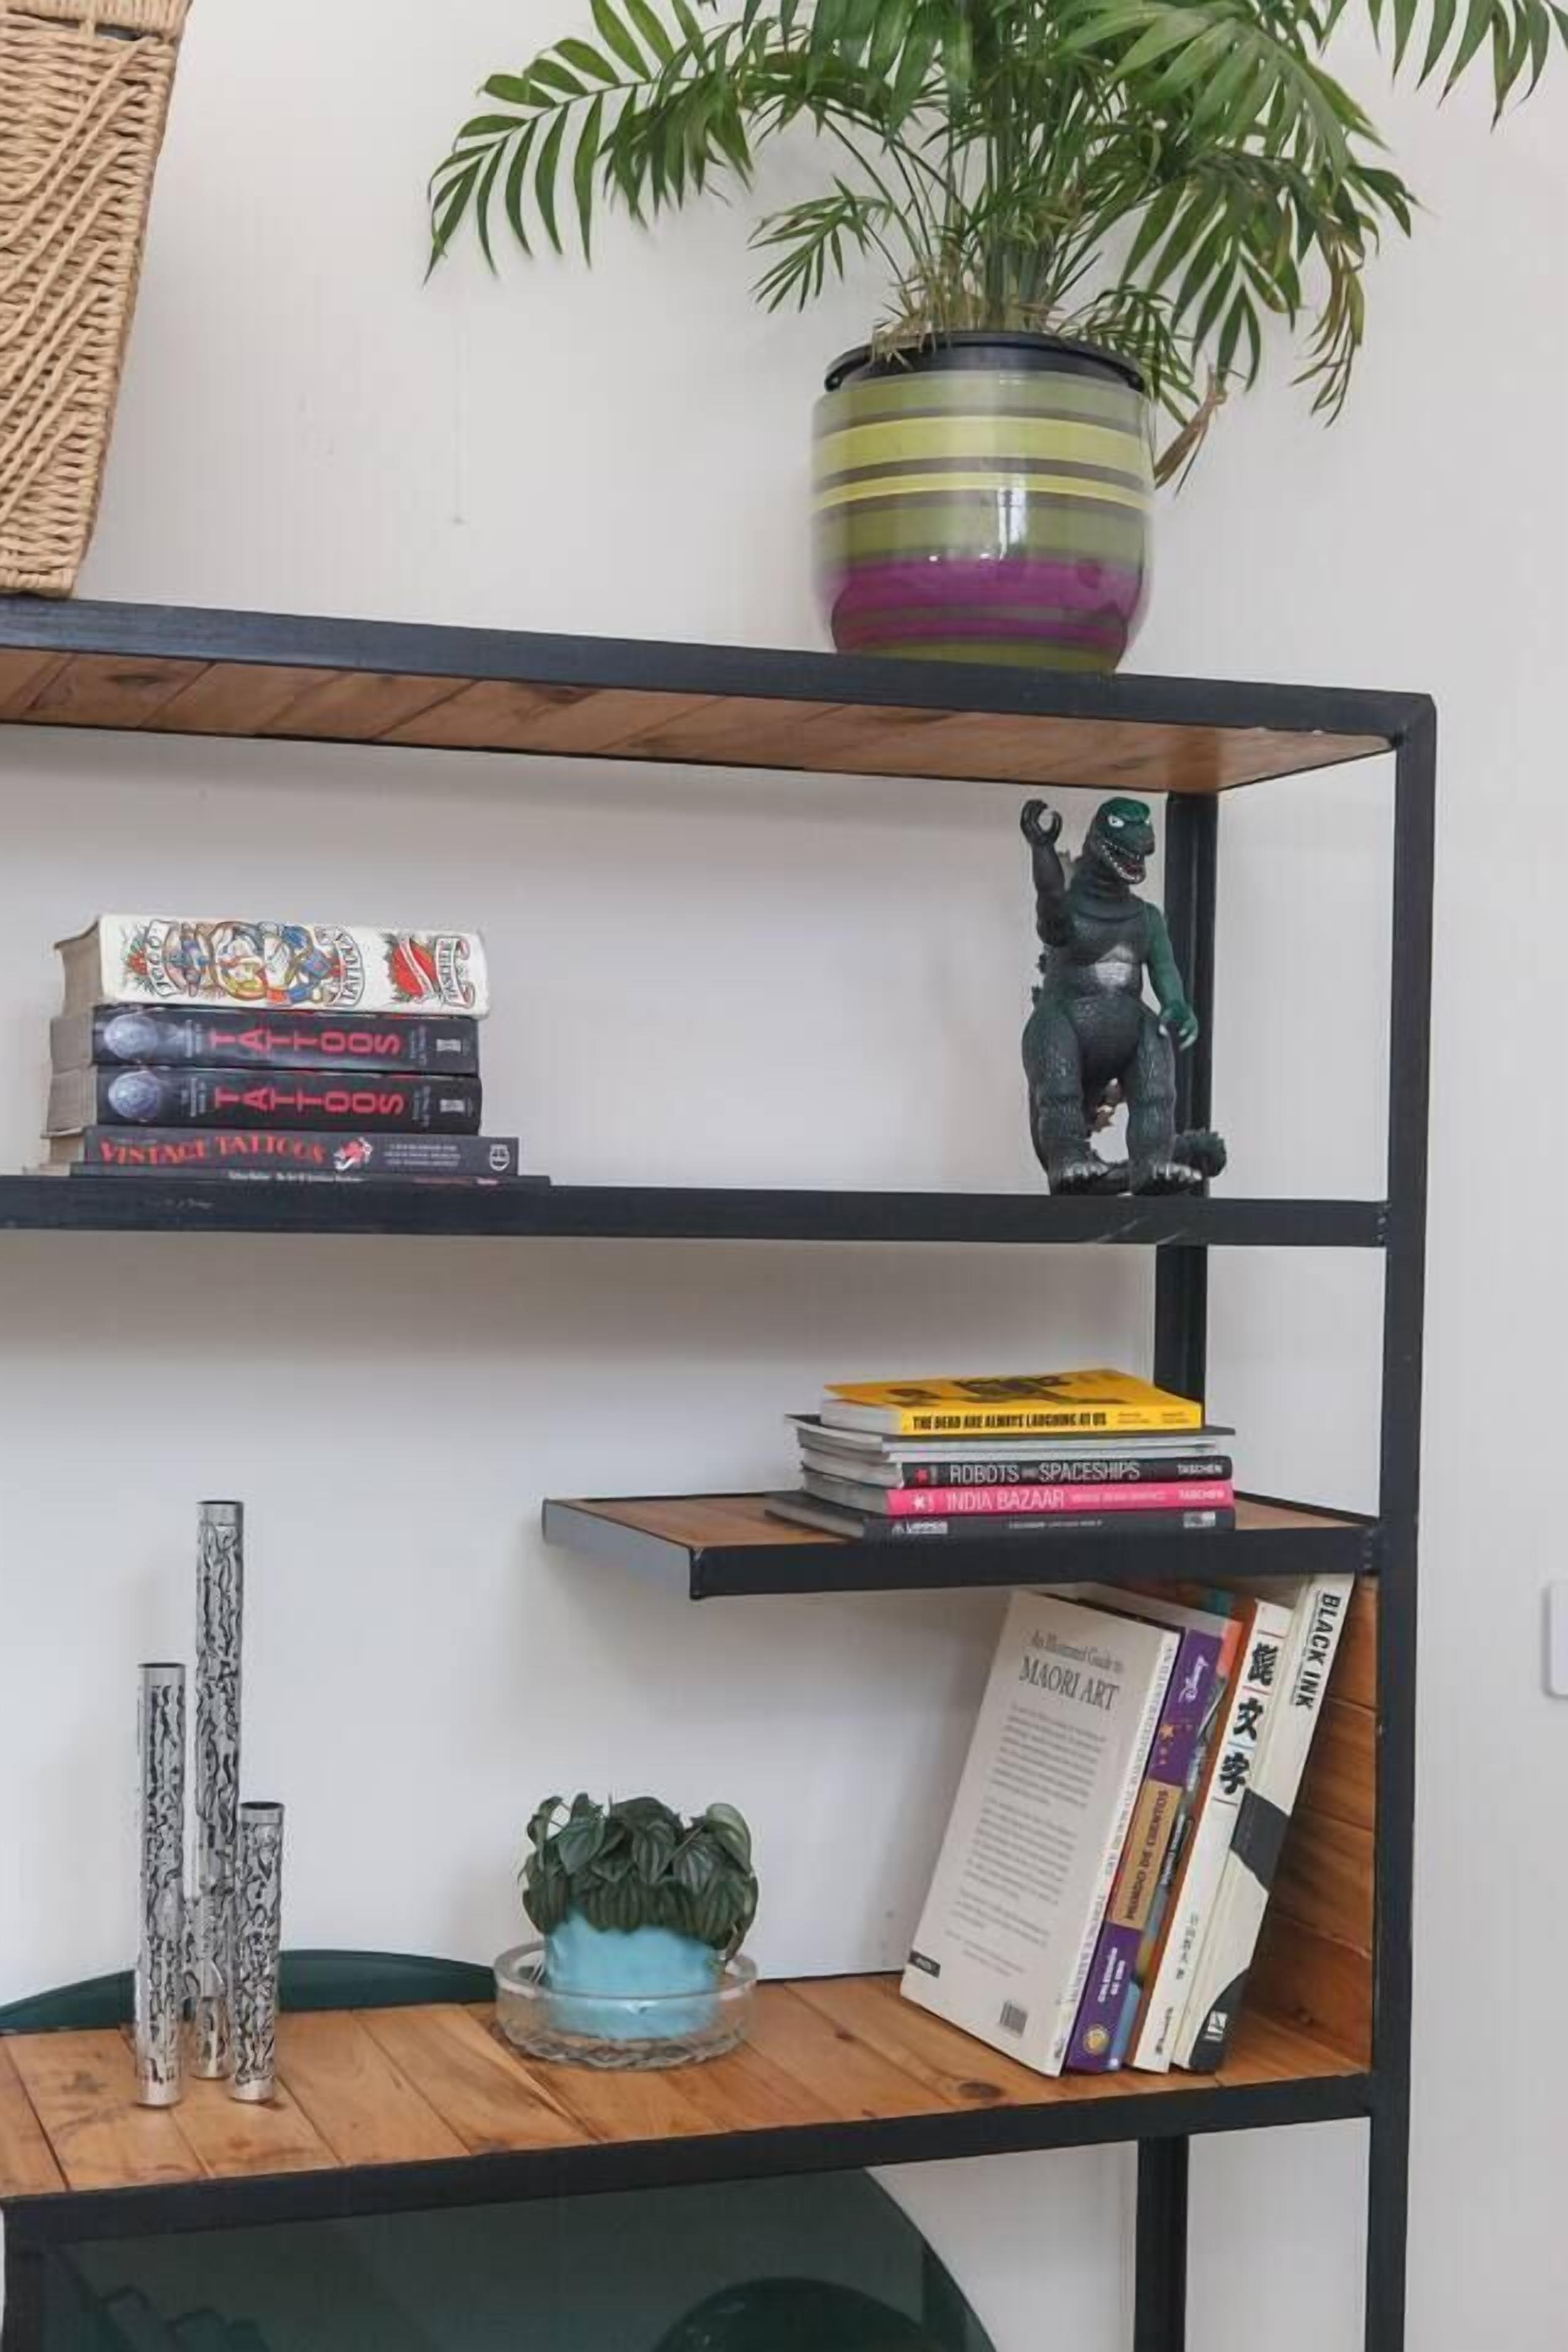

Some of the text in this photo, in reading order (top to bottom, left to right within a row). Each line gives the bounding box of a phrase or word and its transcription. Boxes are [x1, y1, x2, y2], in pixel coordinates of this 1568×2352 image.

[209, 1028, 401, 1055] TATTOOS
[214, 1087, 405, 1115] TATTOOS
[913, 1416, 932, 1430] THE
[949, 1464, 1020, 1483] ROBOTS
[1038, 1461, 1140, 1483] SPACESHIPS
[946, 1491, 993, 1510] INDIA
[997, 1488, 1065, 1510] BAZAAR
[1295, 1594, 1341, 1709] BLACK INK
[1018, 1656, 1120, 1711] MAORI ART
